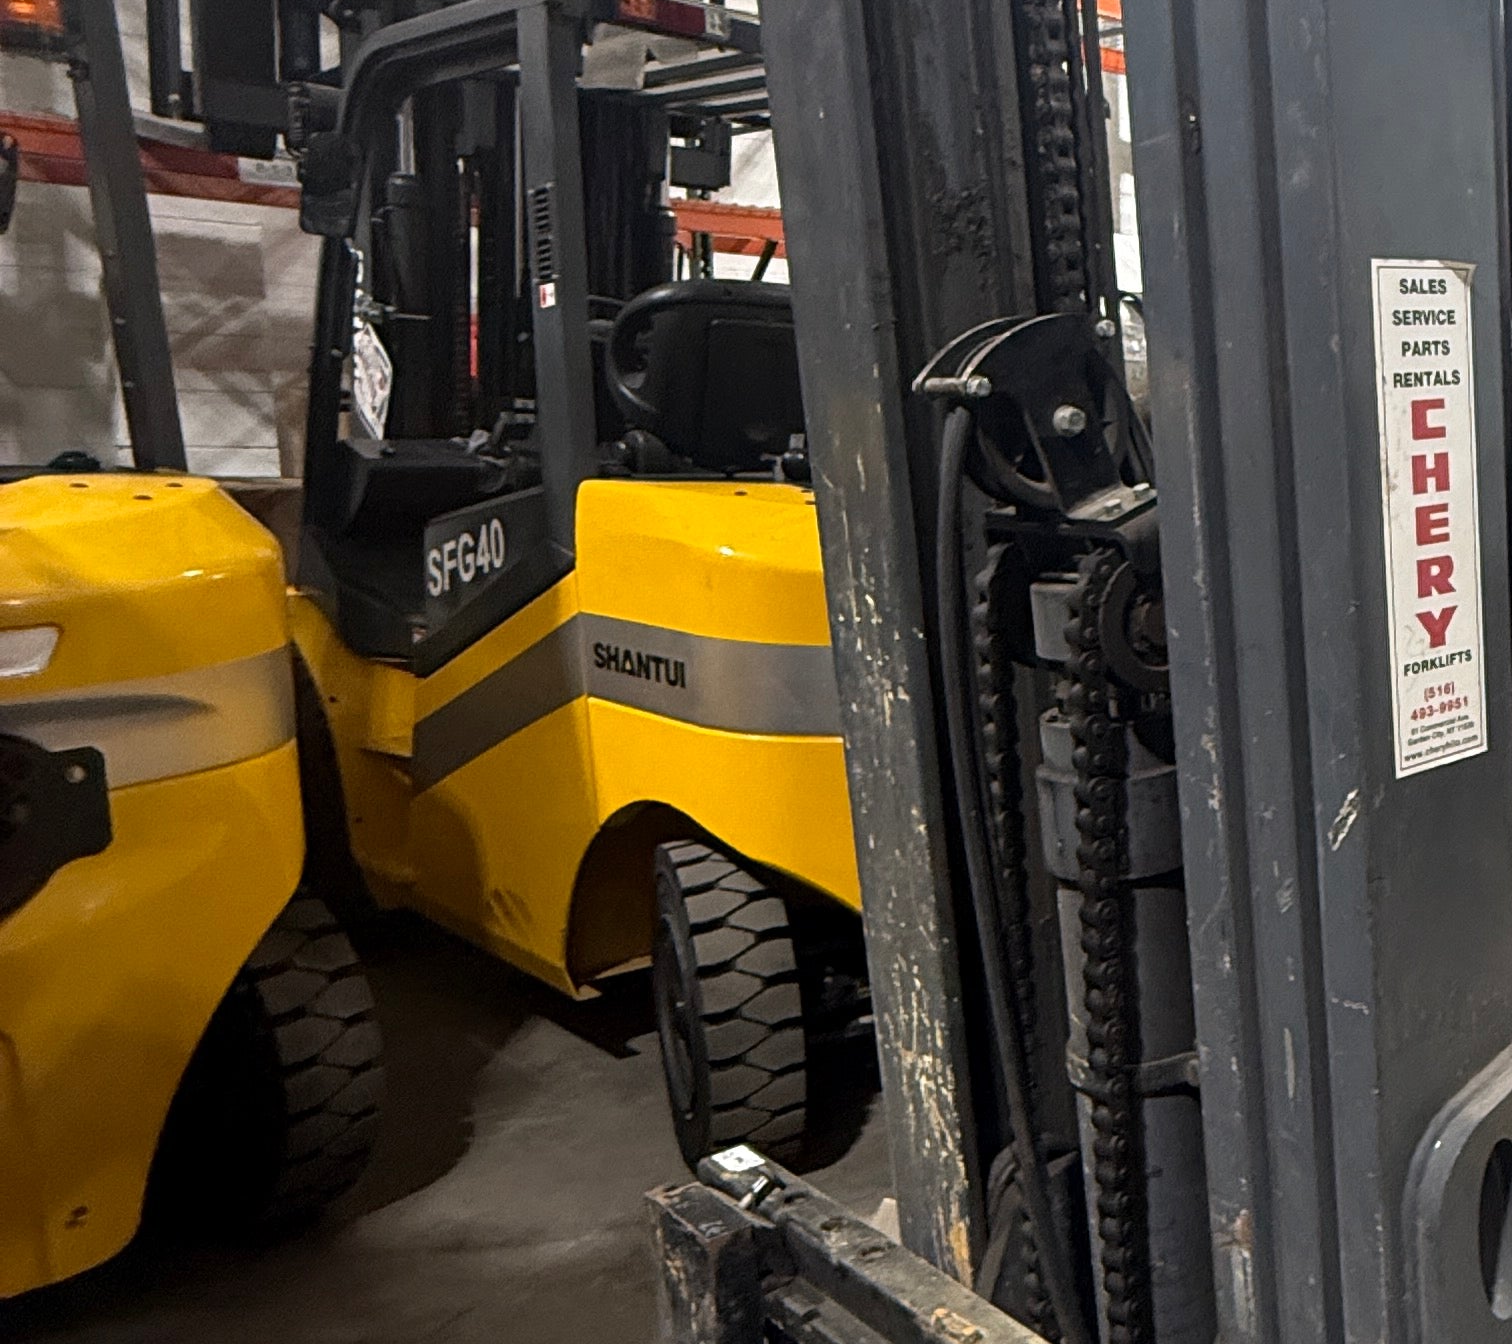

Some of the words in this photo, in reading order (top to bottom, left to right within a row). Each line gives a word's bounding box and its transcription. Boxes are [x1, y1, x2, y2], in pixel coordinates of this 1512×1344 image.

[1399, 278, 1447, 295] SALES
[1392, 309, 1456, 326] SERVICE
[1401, 340, 1451, 357] PARTS
[1393, 369, 1461, 388] RENTALS
[1411, 398, 1458, 649] CHERY
[427, 517, 506, 597] SFG40
[593, 642, 686, 689] SHANTUI
[1403, 648, 1473, 677] FORKLIFTS
[1424, 681, 1455, 702] (516)
